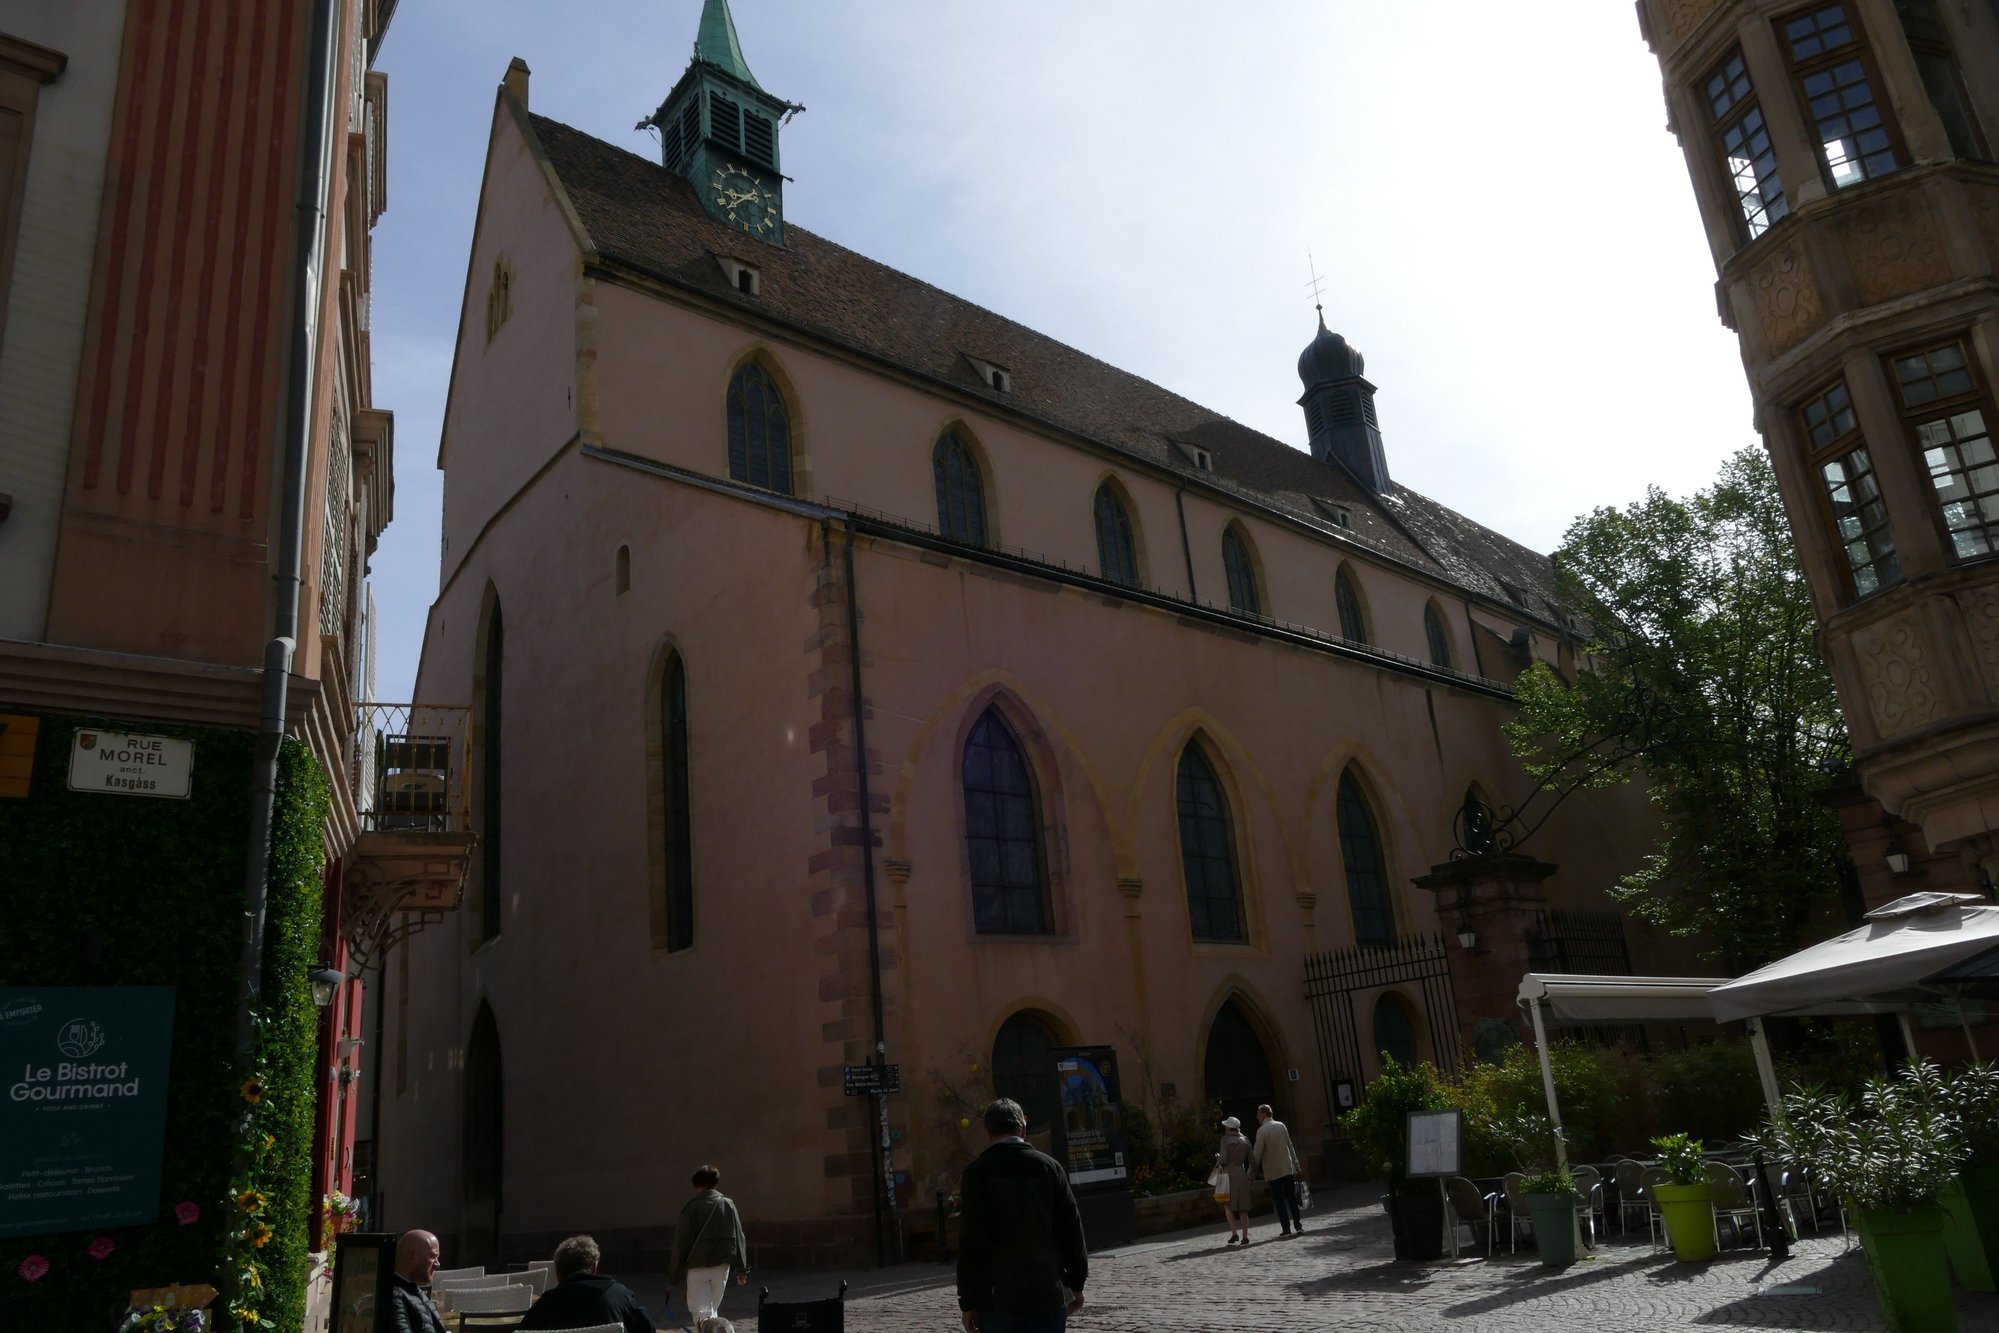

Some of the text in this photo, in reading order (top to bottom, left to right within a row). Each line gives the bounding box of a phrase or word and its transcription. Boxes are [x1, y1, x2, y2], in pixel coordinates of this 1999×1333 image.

[127, 739, 163, 751] RUE
[99, 749, 167, 766] MOREL
[119, 766, 146, 775] anct.
[4, 1004, 43, 1020] EMPORTER
[25, 1061, 129, 1083] Le Bistrot
[10, 1077, 140, 1103] Gourmand
